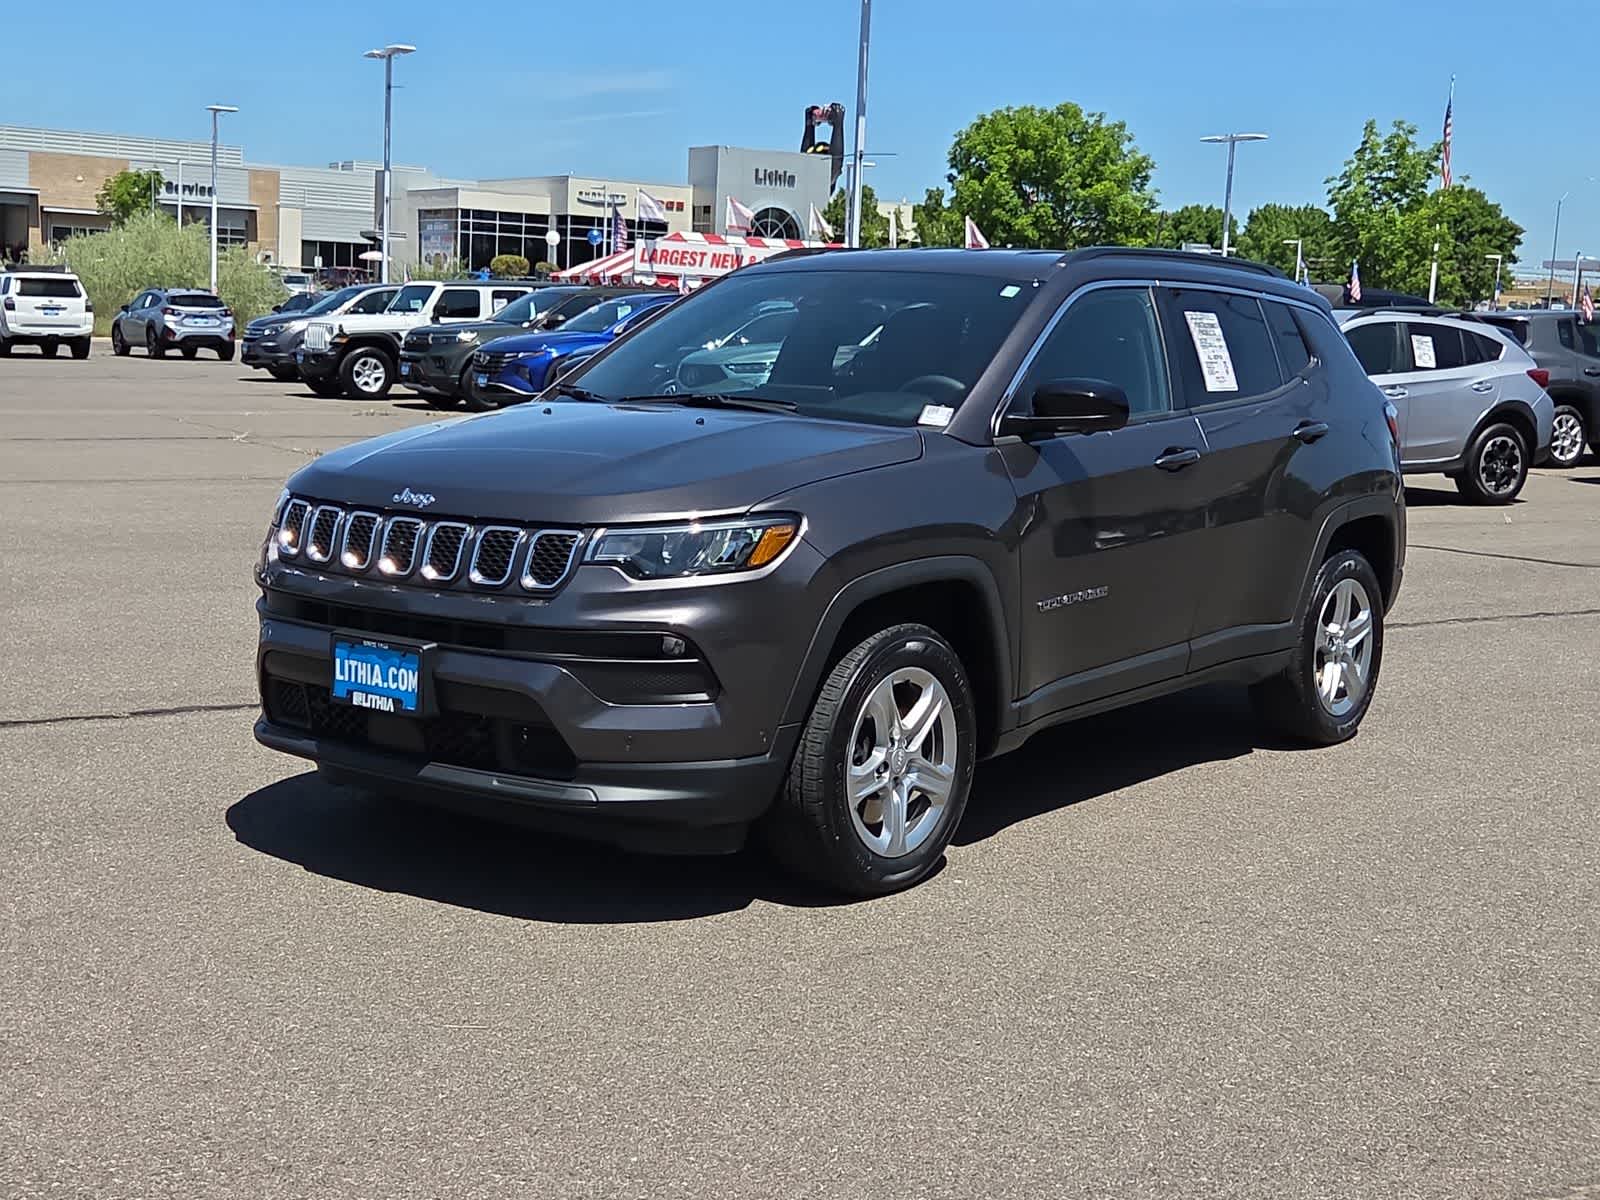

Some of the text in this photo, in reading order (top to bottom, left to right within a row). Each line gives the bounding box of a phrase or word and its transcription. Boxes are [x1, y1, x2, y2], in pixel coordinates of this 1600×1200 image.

[755, 168, 796, 188] Lithia
[640, 248, 706, 267] LARGEST
[710, 252, 744, 269] NEW
[393, 488, 435, 508] Jeep
[335, 658, 419, 694] LITHIA.COM
[362, 692, 394, 712] LITHIA
